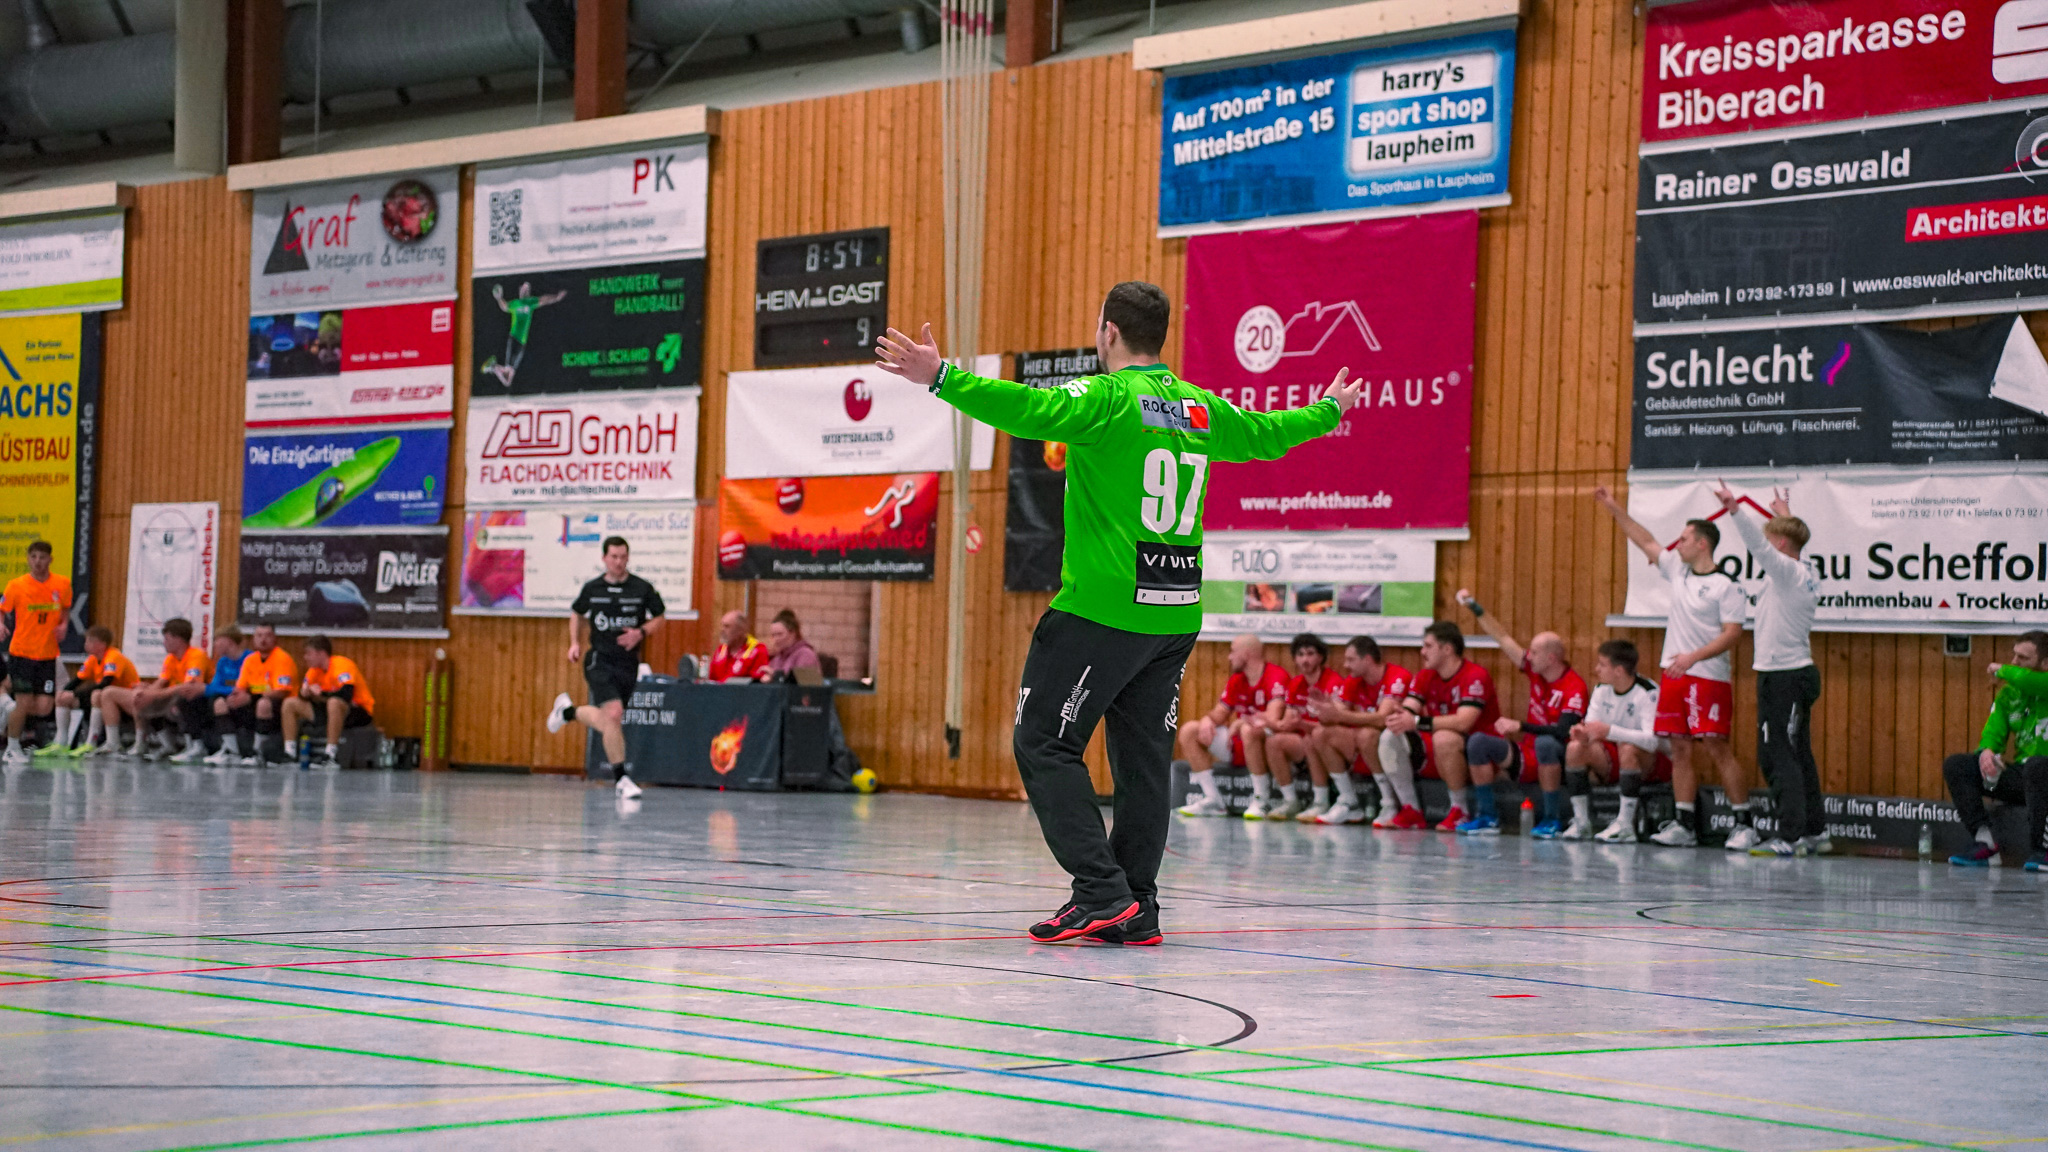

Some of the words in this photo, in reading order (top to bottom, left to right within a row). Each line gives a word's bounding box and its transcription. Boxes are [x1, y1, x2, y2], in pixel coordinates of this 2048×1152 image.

[1658, 9, 1967, 80] Kreissparkasse
[1382, 62, 1465, 92] harry's
[1172, 106, 1206, 133] Auf
[1276, 84, 1297, 108] in
[1302, 77, 1335, 102] der
[1358, 101, 1421, 134] sport
[1426, 95, 1487, 124] shop
[1657, 74, 1825, 129] Biberach
[1173, 116, 1304, 166] Mittelstraße
[1309, 106, 1335, 134] 15
[1367, 130, 1475, 164] laupheim
[1347, 183, 1369, 198] Das
[1370, 179, 1422, 197] Sporthaus
[1424, 176, 1436, 190] in
[1437, 171, 1495, 189] Laupheim
[1655, 170, 1758, 201] Rainer
[1770, 147, 1910, 190] Osswald
[282, 193, 361, 256] Graf
[1911, 203, 2048, 237] Architekt
[805, 238, 864, 272] 8:54
[589, 273, 661, 297] HANDWERK
[756, 288, 810, 312] HEIM
[828, 281, 885, 306] GAST
[1652, 289, 1718, 308] Laupheim
[857, 317, 870, 347] 9
[1246, 325, 1274, 352] 20
[1023, 358, 1053, 376] HIER
[1054, 354, 1098, 374] FEUERT
[1646, 346, 1814, 389] Schlecht
[1645, 394, 1742, 411] Gebäudetechnik
[1746, 391, 1785, 405] GmbH
[579, 412, 678, 456] GmbH
[1644, 422, 1685, 437] Sanitär.
[1689, 420, 1737, 436] Heizung.
[0, 432, 71, 463] ÜSTBAU
[249, 446, 271, 465] Die
[480, 459, 674, 485] FLACHDACHTECHNIK
[1140, 448, 1208, 536] 97
[1240, 489, 1393, 515] www.perfekthaus.de
[1232, 548, 1280, 575] PUZO
[1867, 541, 2048, 582] Scheffol
[1816, 590, 1933, 608] zrahmenbau
[1068, 684, 1084, 704] GmbH
[1708, 702, 1720, 722] 4
[1761, 720, 1769, 744] 1
[1824, 796, 1843, 815] für
[1846, 798, 1874, 817] Ihre
[1825, 821, 1877, 840] gesetzt.
